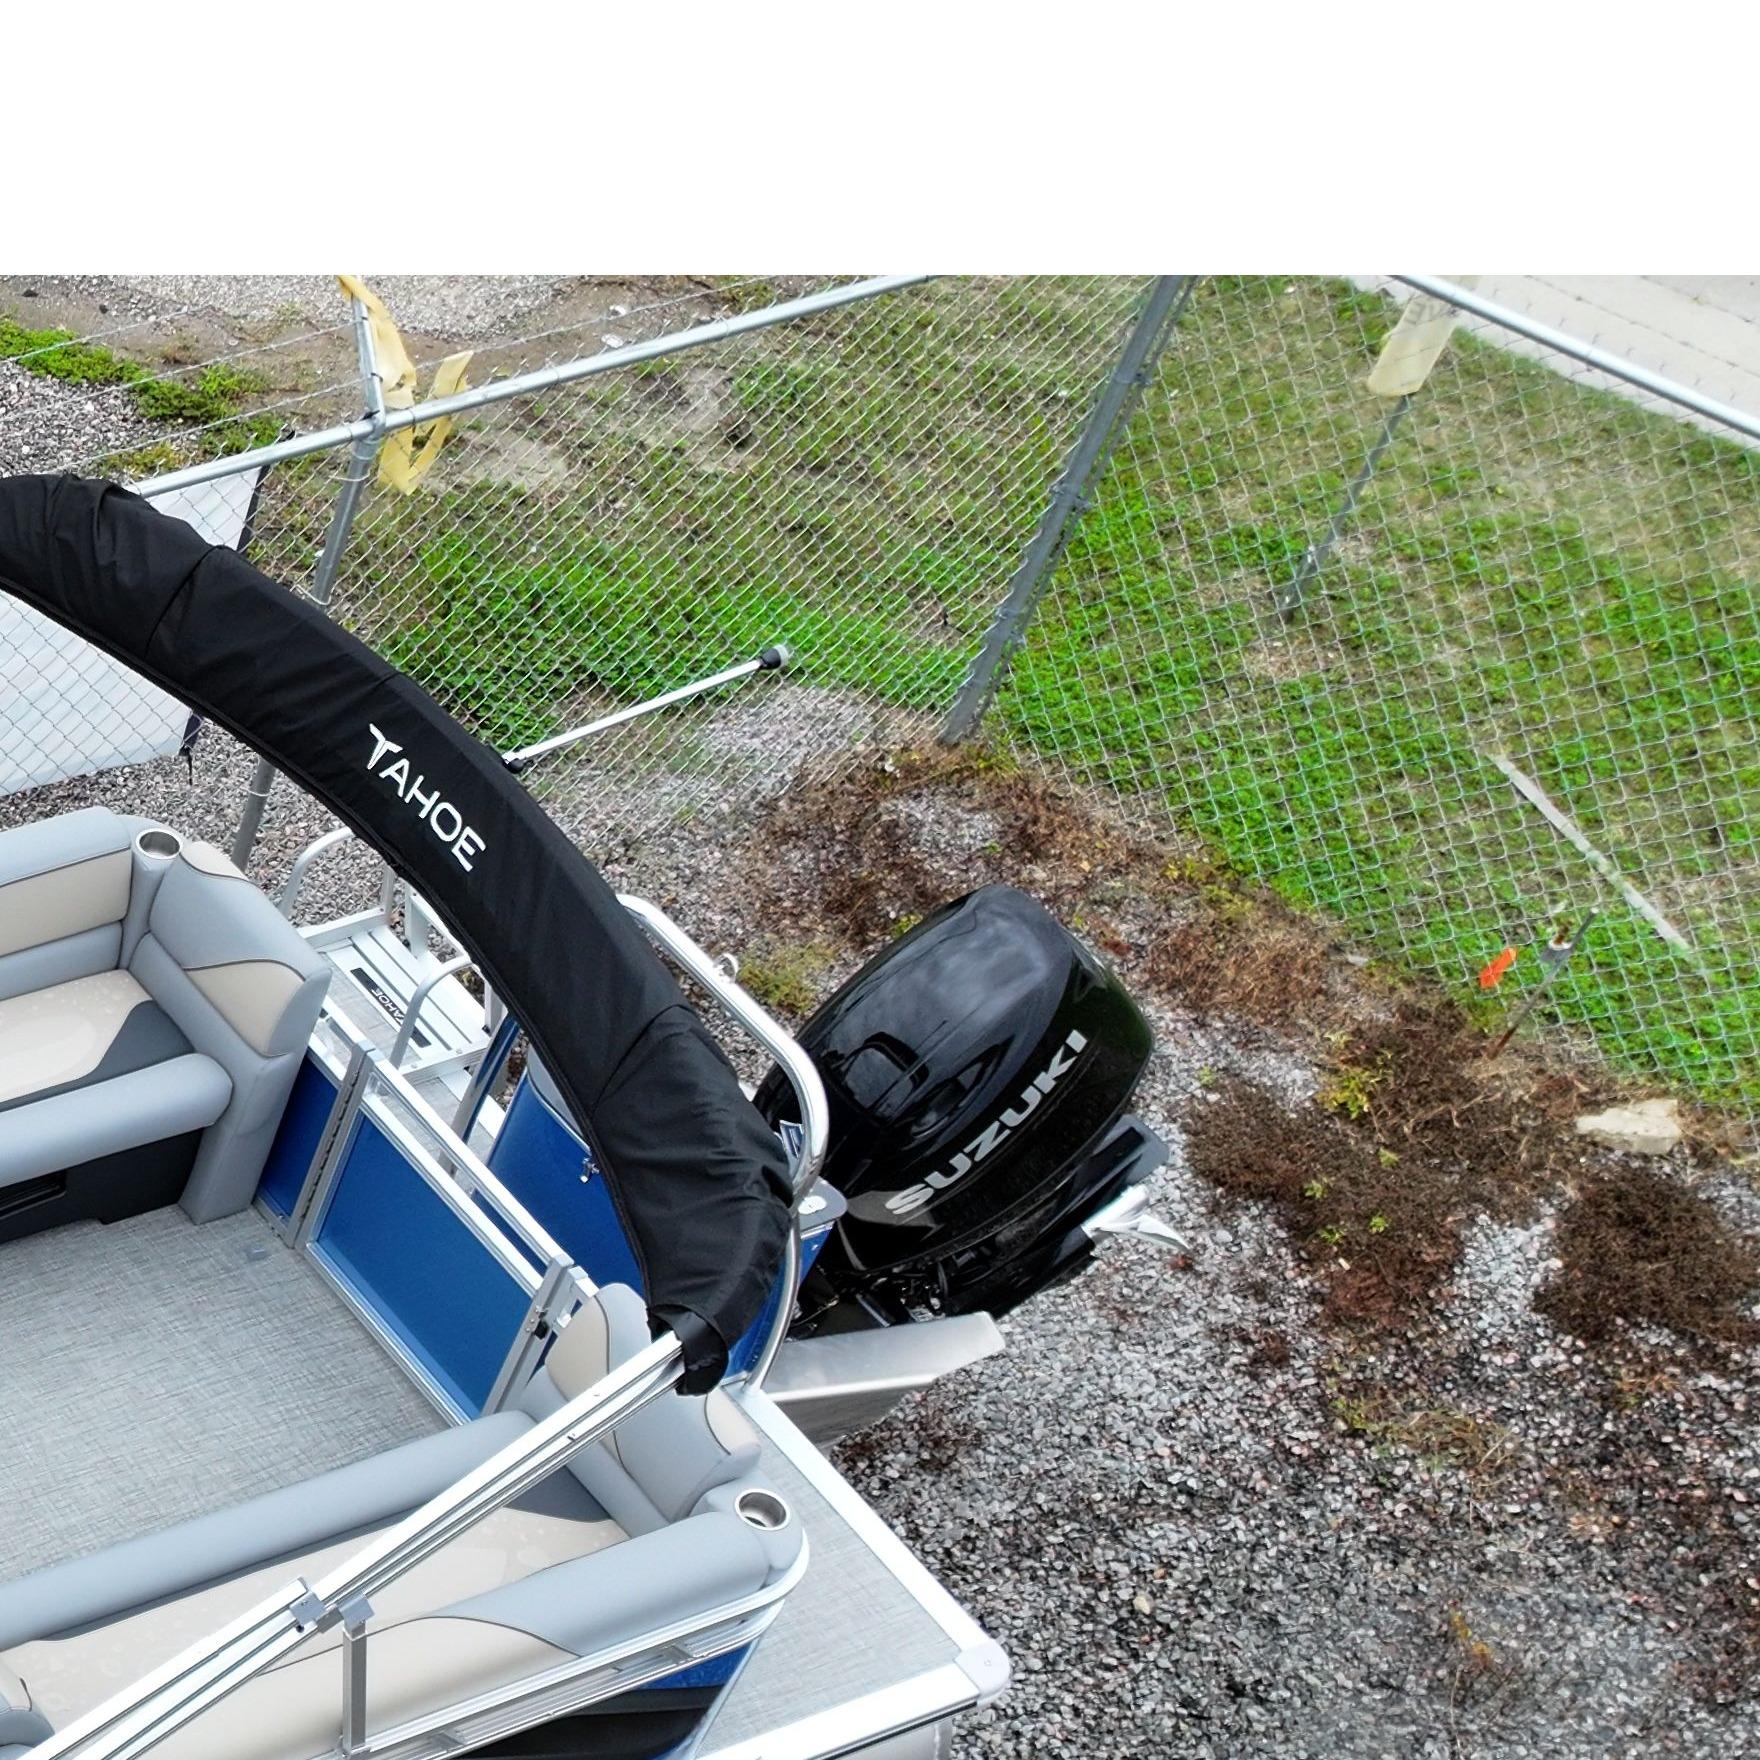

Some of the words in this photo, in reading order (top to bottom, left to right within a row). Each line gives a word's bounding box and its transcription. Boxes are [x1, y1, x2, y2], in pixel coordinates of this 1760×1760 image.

[369, 723, 486, 872] TAHOE
[371, 985, 408, 1025] AHOE
[884, 1029, 1088, 1215] SUZUKI
